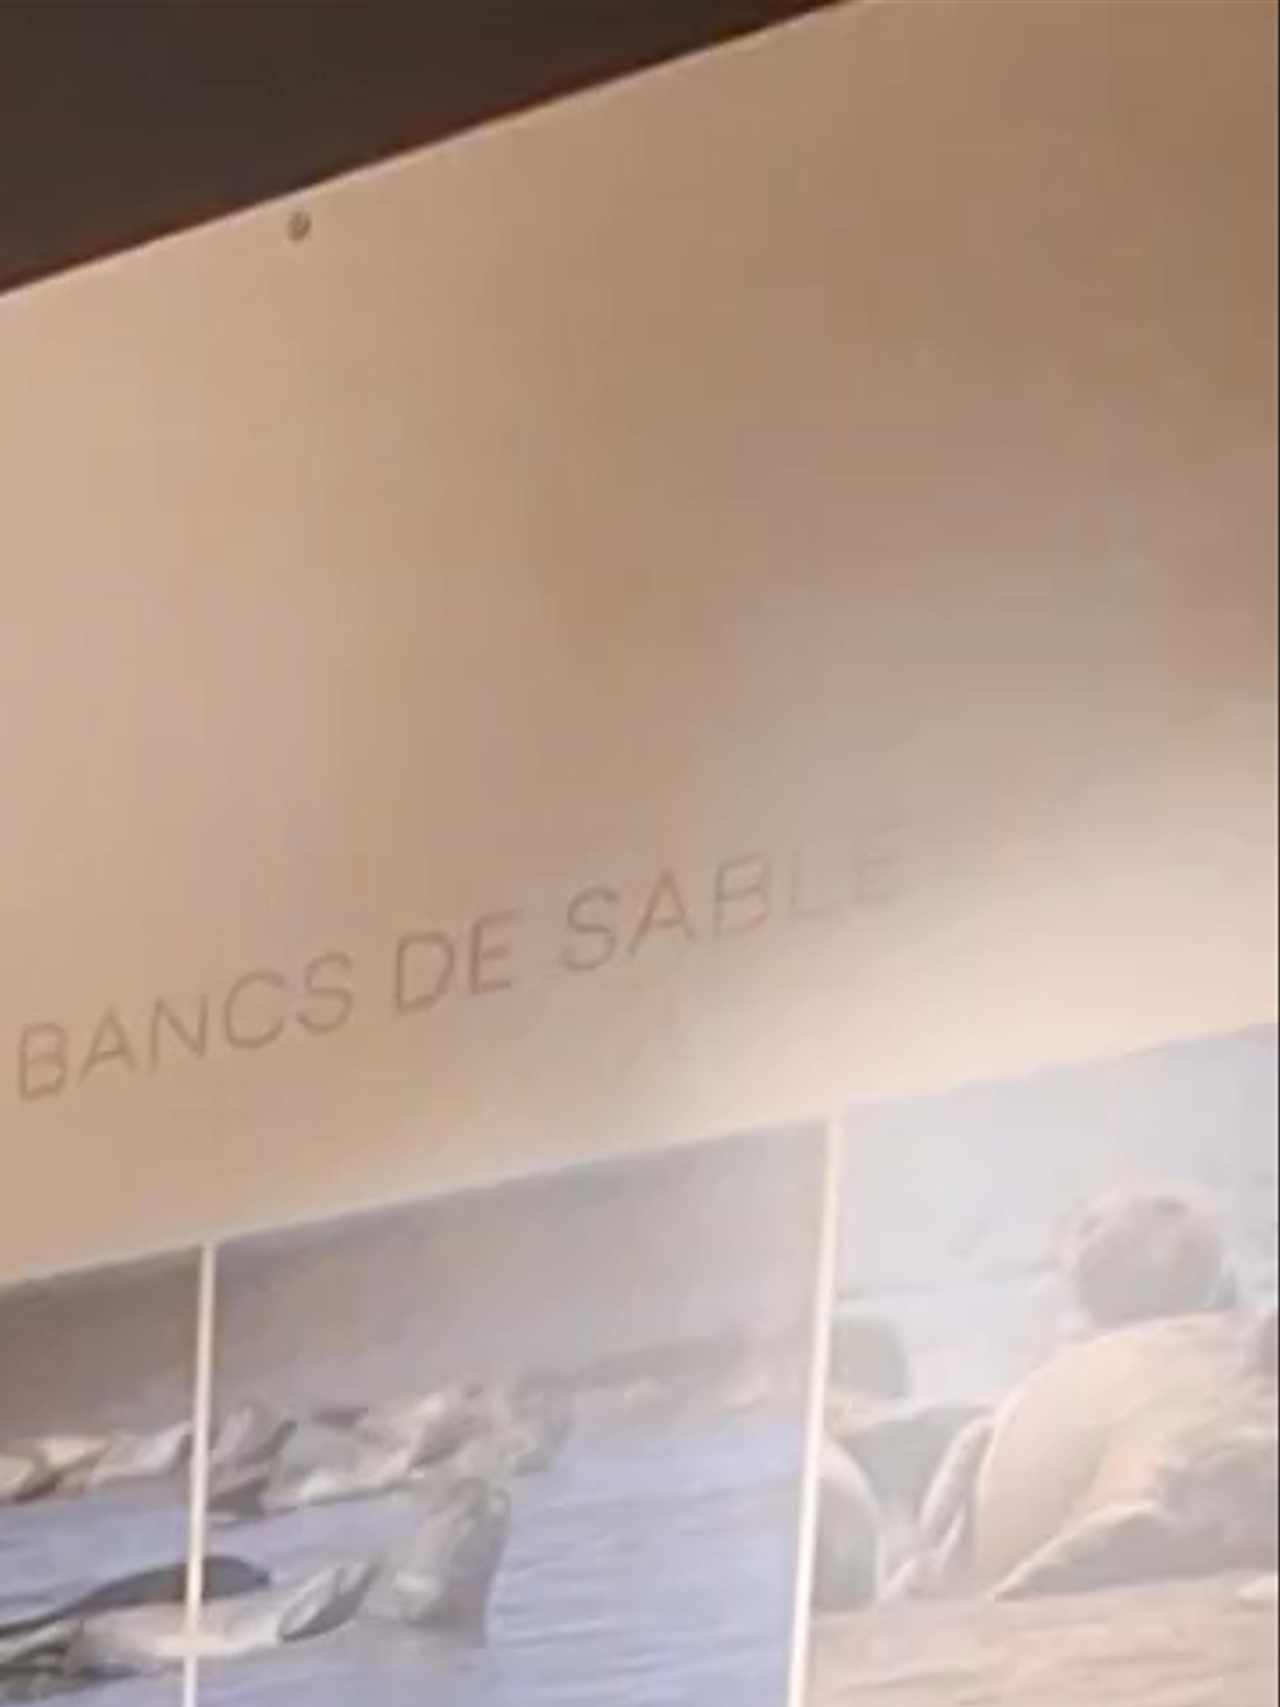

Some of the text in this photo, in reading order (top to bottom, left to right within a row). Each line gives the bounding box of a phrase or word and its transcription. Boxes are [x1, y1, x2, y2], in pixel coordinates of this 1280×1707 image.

[16, 950, 355, 1102] BANCS
[395, 907, 525, 1018] DE
[560, 822, 912, 972] SABLE
